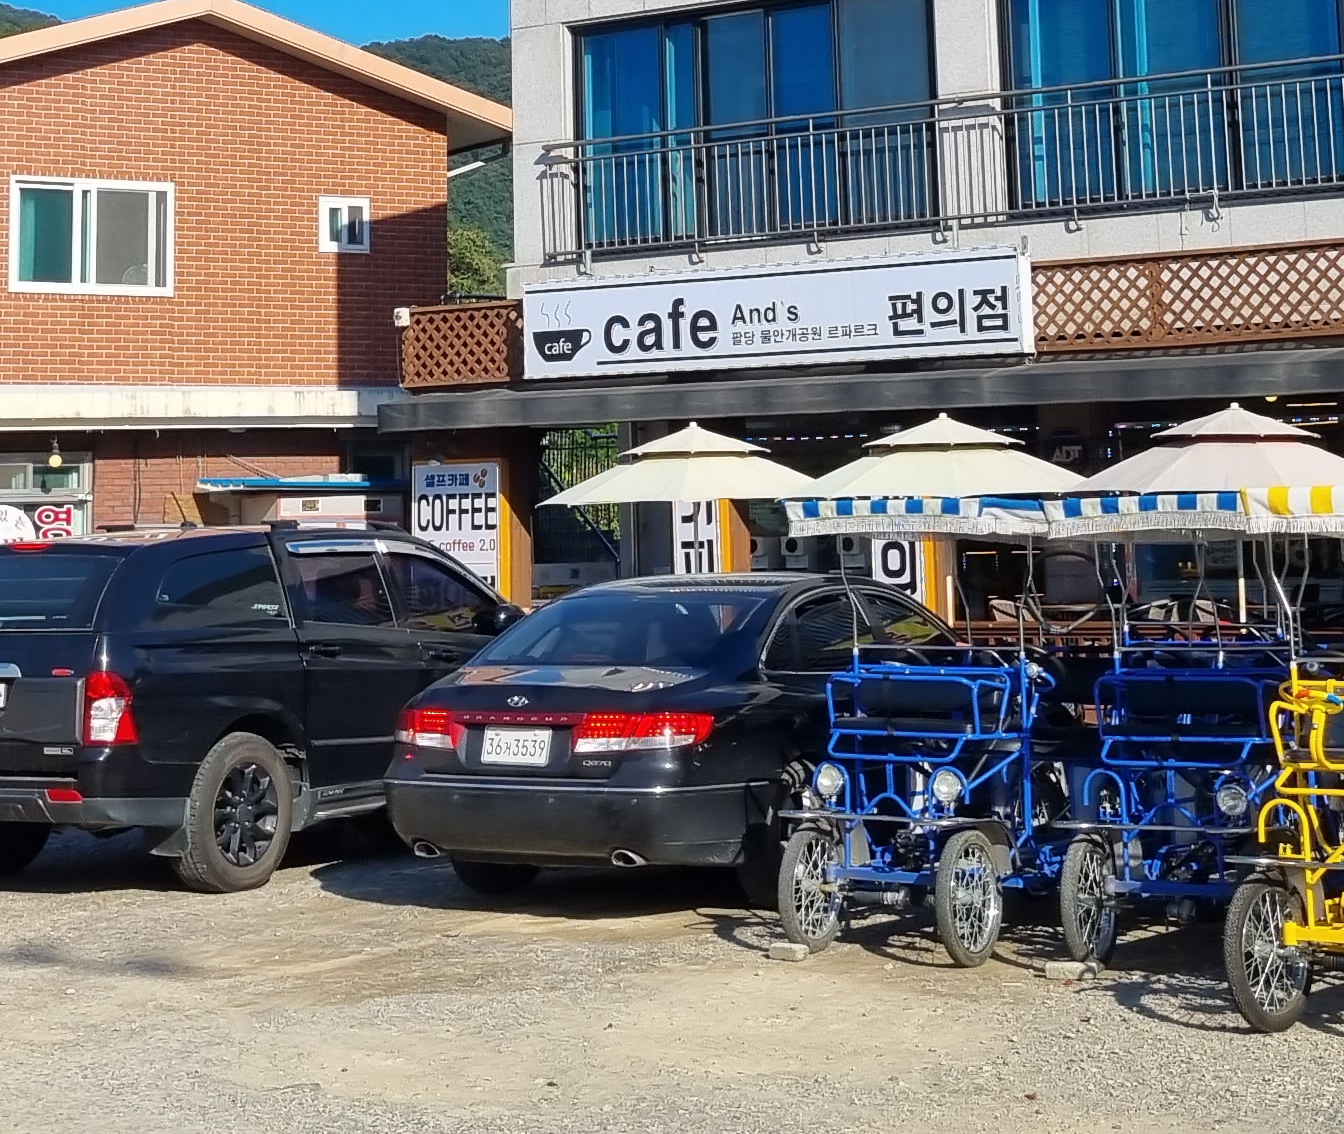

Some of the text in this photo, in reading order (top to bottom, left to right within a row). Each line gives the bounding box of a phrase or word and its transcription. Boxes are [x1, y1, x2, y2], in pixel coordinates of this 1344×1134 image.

[604, 285, 1010, 355] cafe And's 편의점
[732, 323, 879, 346] 팔당 물안개공원 르파르크
[544, 338, 573, 354] cafe
[1049, 445, 1083, 463] ADT
[418, 492, 496, 532] COFFEE
[439, 538, 496, 552] coffee 2.0
